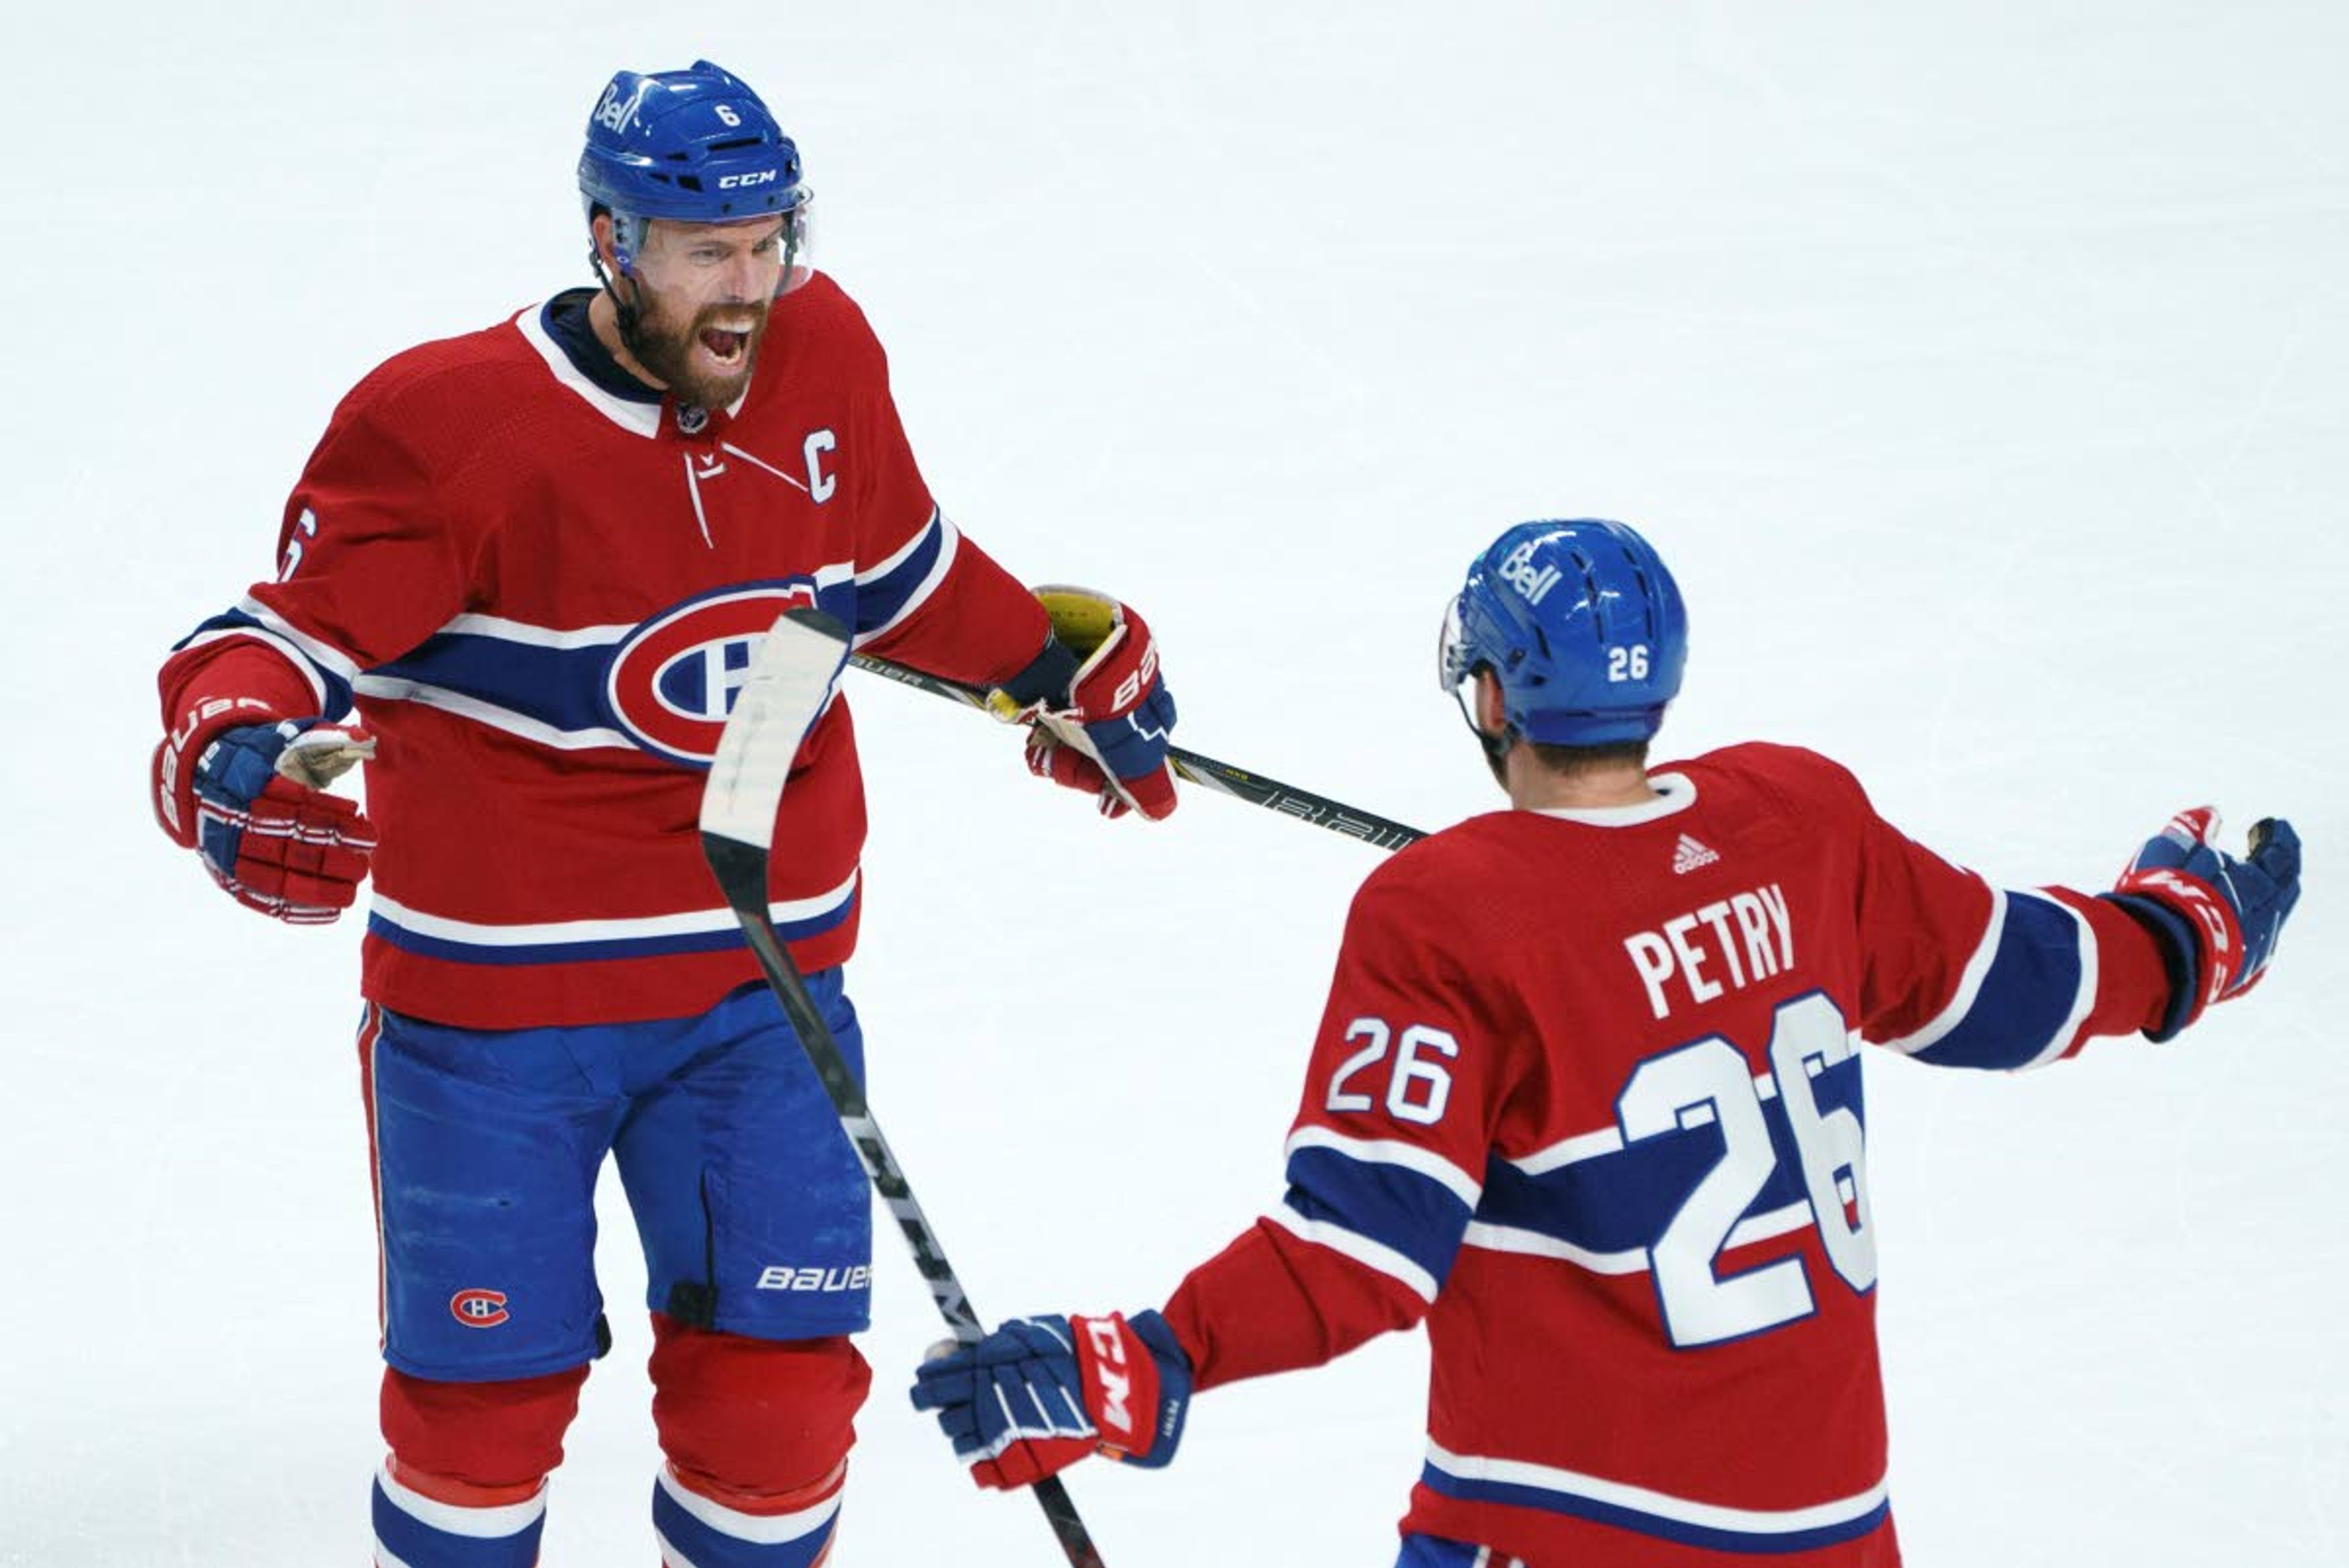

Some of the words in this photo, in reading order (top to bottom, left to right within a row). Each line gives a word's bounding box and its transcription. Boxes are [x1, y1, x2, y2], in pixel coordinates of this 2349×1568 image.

[595, 83, 639, 133] Bell
[714, 105, 741, 126] 6
[719, 169, 776, 189] CCM
[804, 429, 836, 503] C
[1499, 542, 1563, 606] Bell
[1608, 645, 1648, 682] 26
[1624, 883, 1794, 1020] PETRY
[1325, 1017, 1459, 1125] 26
[1612, 987, 1878, 1351] 26
